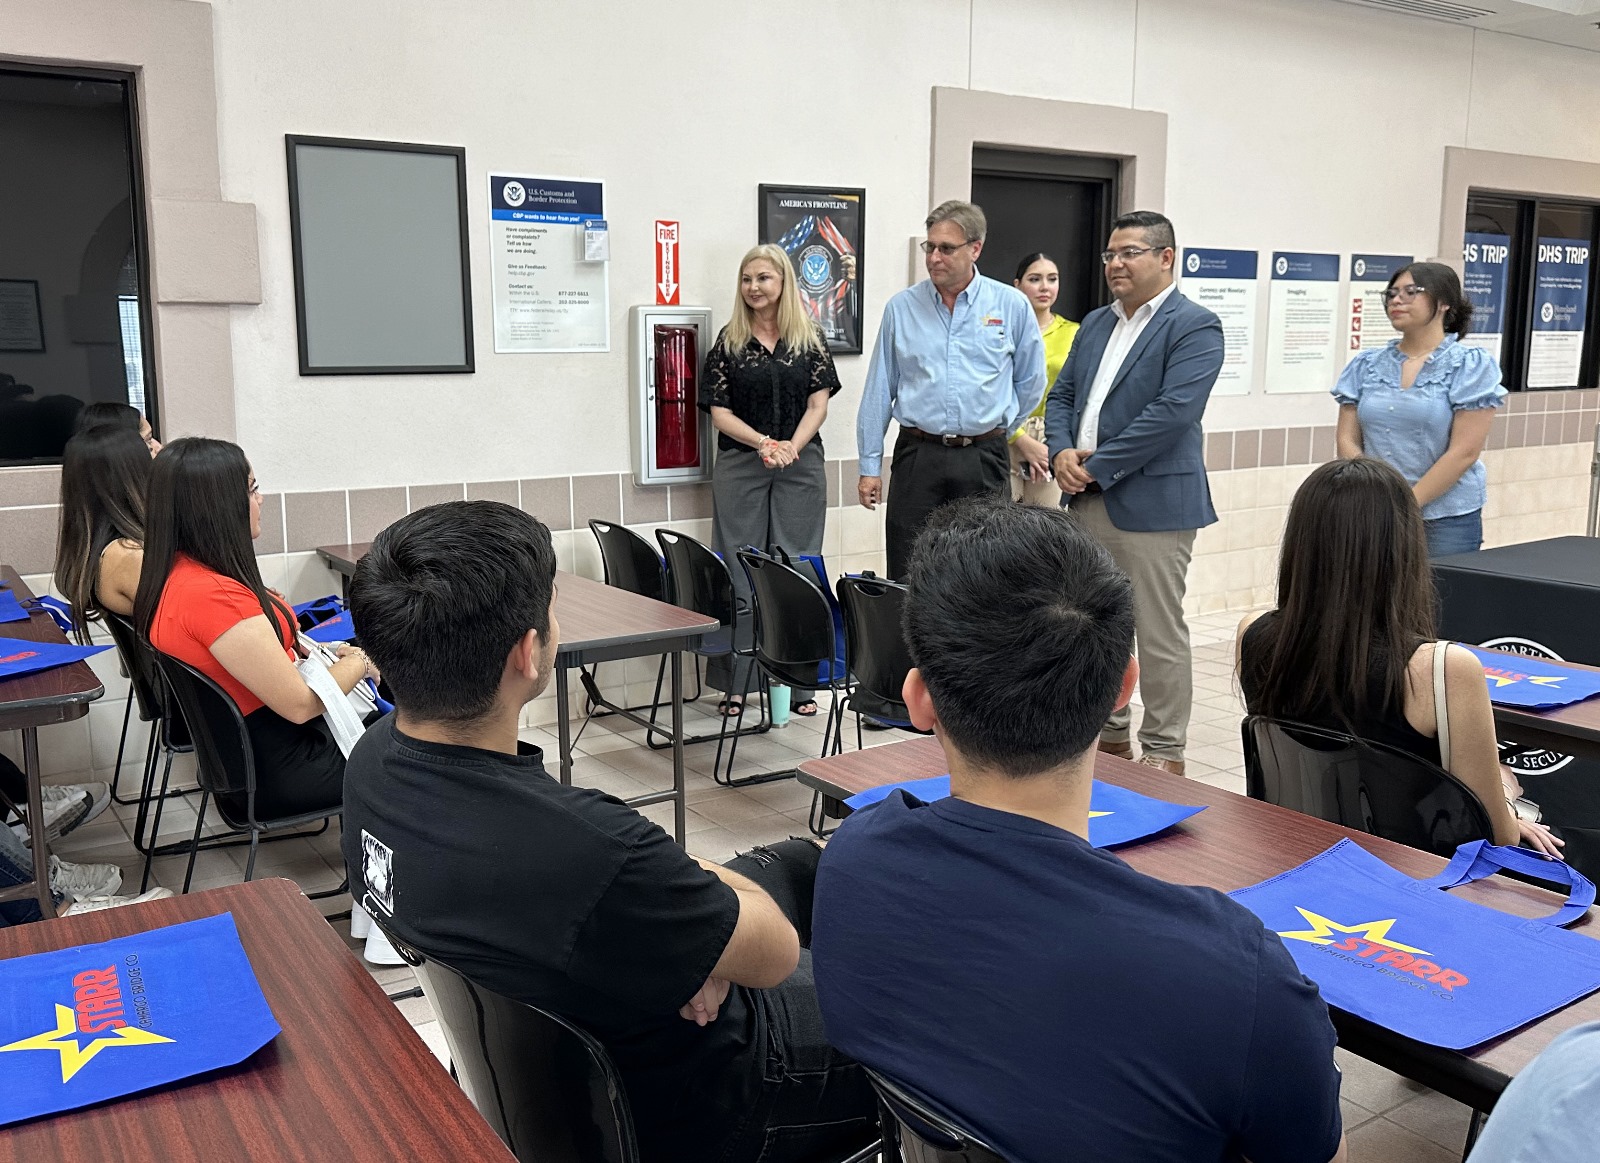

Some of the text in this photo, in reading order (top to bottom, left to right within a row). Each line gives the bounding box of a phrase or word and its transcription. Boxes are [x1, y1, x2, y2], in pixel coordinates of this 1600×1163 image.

[539, 189, 563, 197] Customs
[564, 190, 575, 198] and
[779, 199, 848, 210] AMERICA'S FRONTLINE
[659, 228, 676, 240] FIRE
[1463, 243, 1508, 264] HS TRIP
[1538, 244, 1589, 265] DHS TRIP
[1310, 942, 1375, 969] CAMARGO
[1377, 967, 1429, 991] BRIDGE
[1332, 937, 1470, 992] STARR
[128, 967, 146, 995] BRIDGE
[73, 964, 128, 1034] STARR
[133, 995, 153, 1029] CAMARGO
